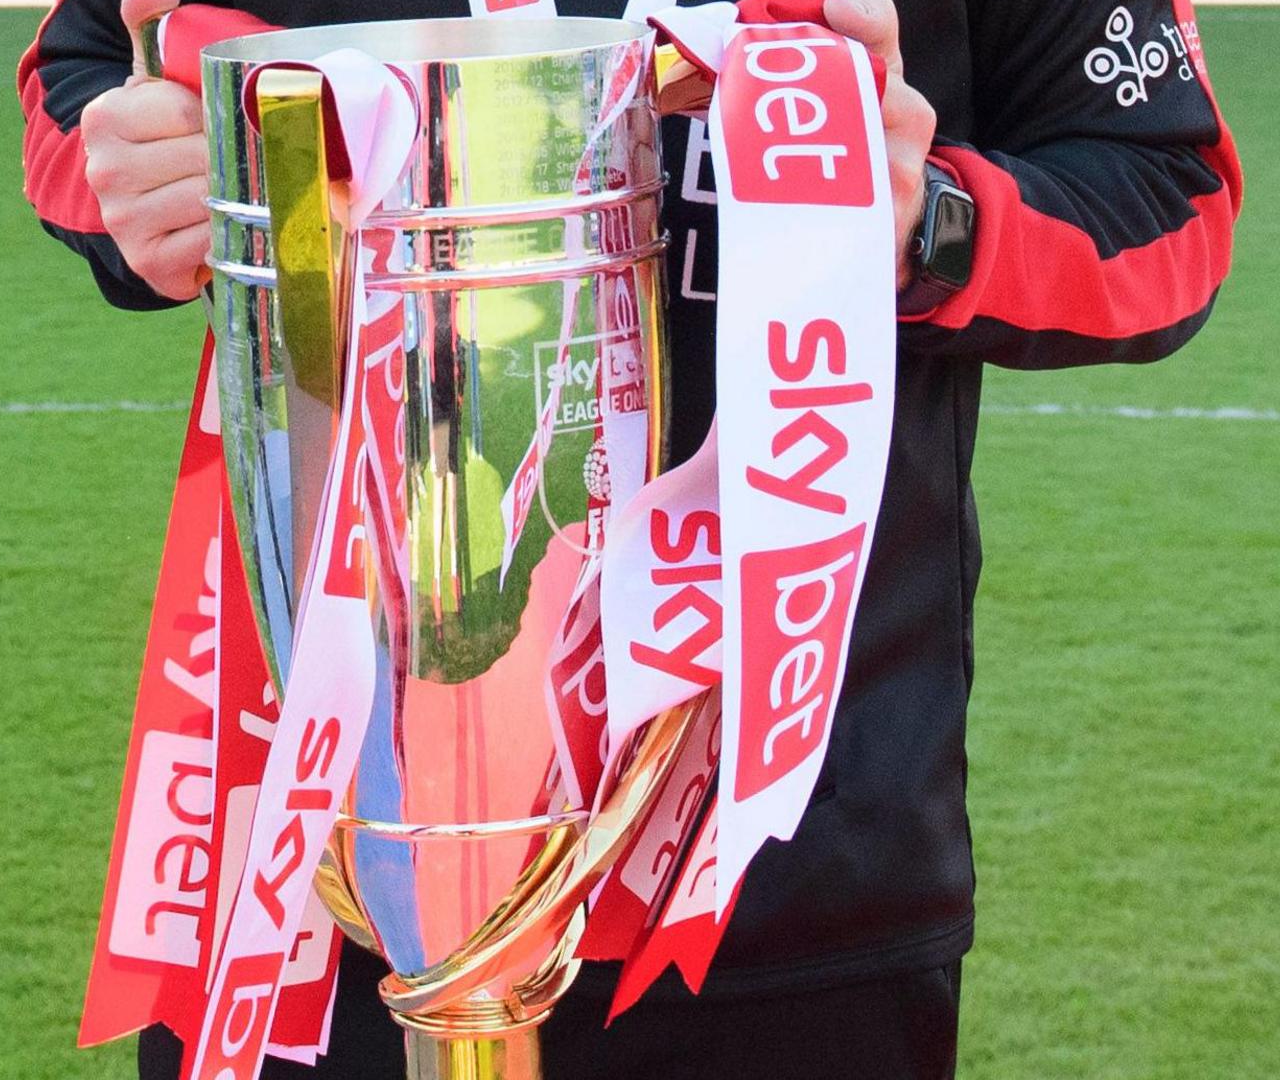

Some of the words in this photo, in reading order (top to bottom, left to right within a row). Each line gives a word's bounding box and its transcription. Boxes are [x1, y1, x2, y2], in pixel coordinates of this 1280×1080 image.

[744, 37, 848, 181] bet
[746, 318, 873, 515] sky
[630, 508, 723, 687] sky
[763, 551, 855, 766] bet
[254, 717, 341, 931] sky
